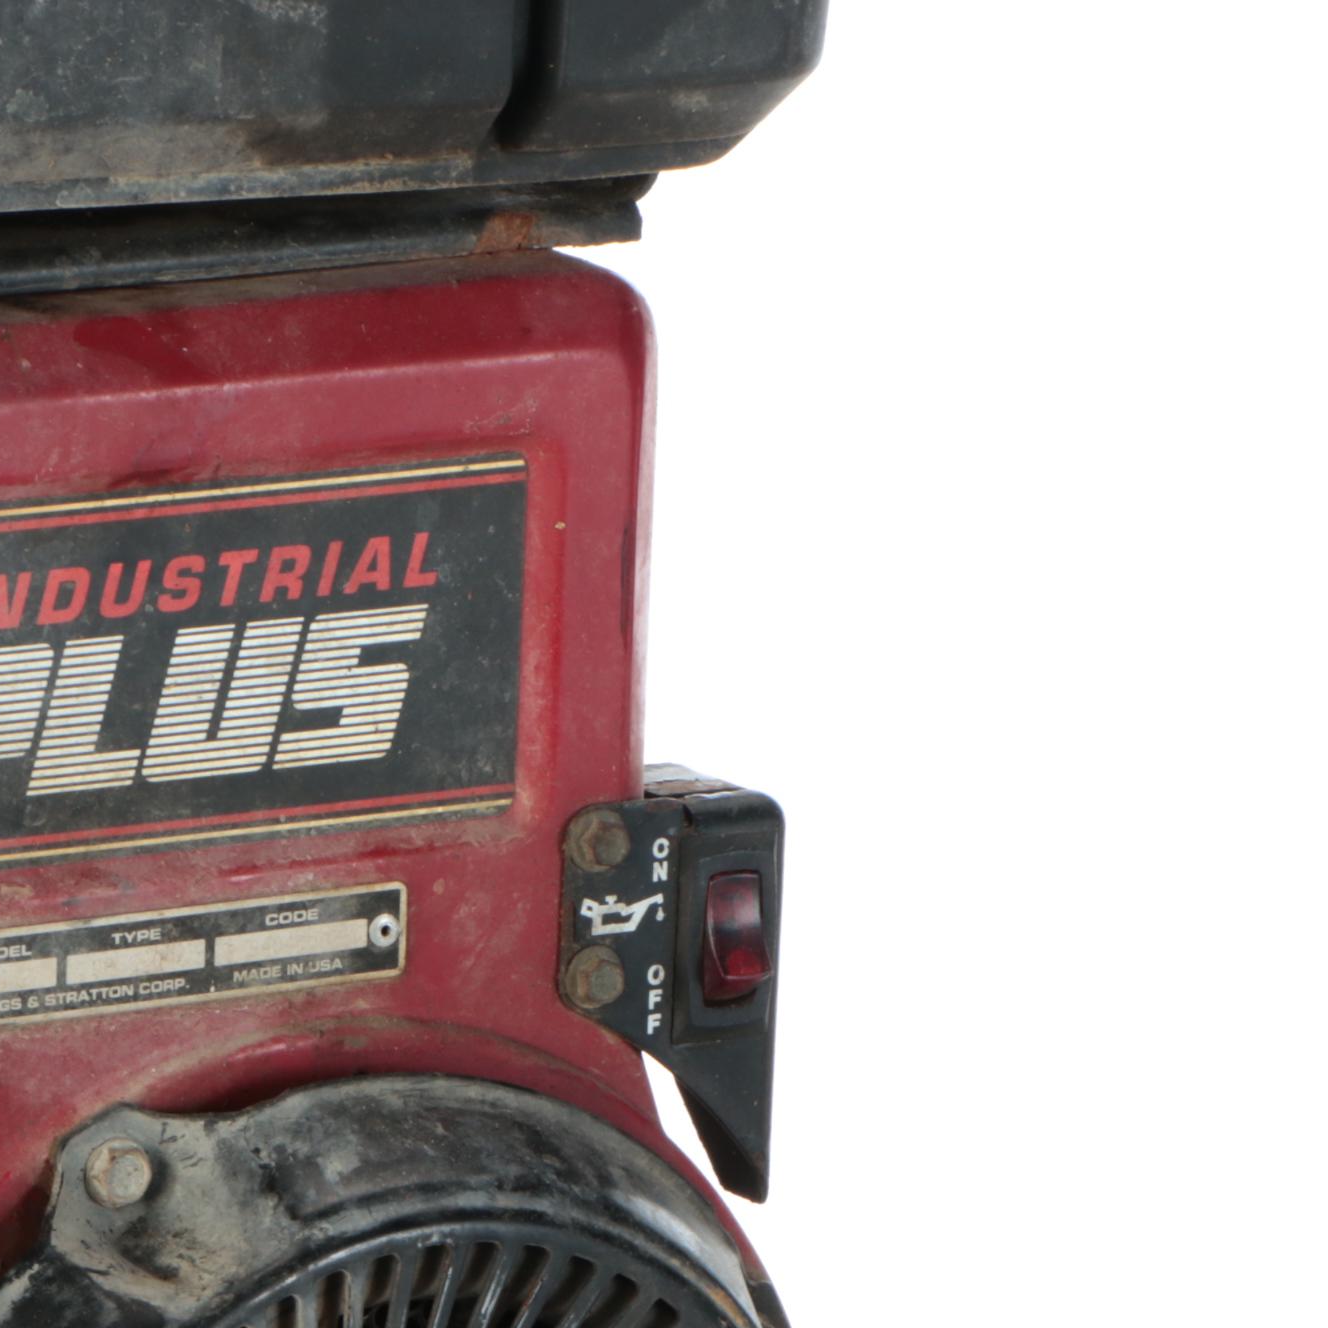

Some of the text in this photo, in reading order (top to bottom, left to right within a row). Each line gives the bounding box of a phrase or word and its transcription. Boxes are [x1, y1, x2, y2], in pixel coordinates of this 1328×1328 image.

[265, 908, 319, 926] CODE
[111, 927, 162, 945] TYPE
[232, 957, 343, 983] MADE IN USA
[27, 996, 39, 1008] &
[44, 984, 134, 1006] STRATTON
[138, 978, 190, 995] CORP.
